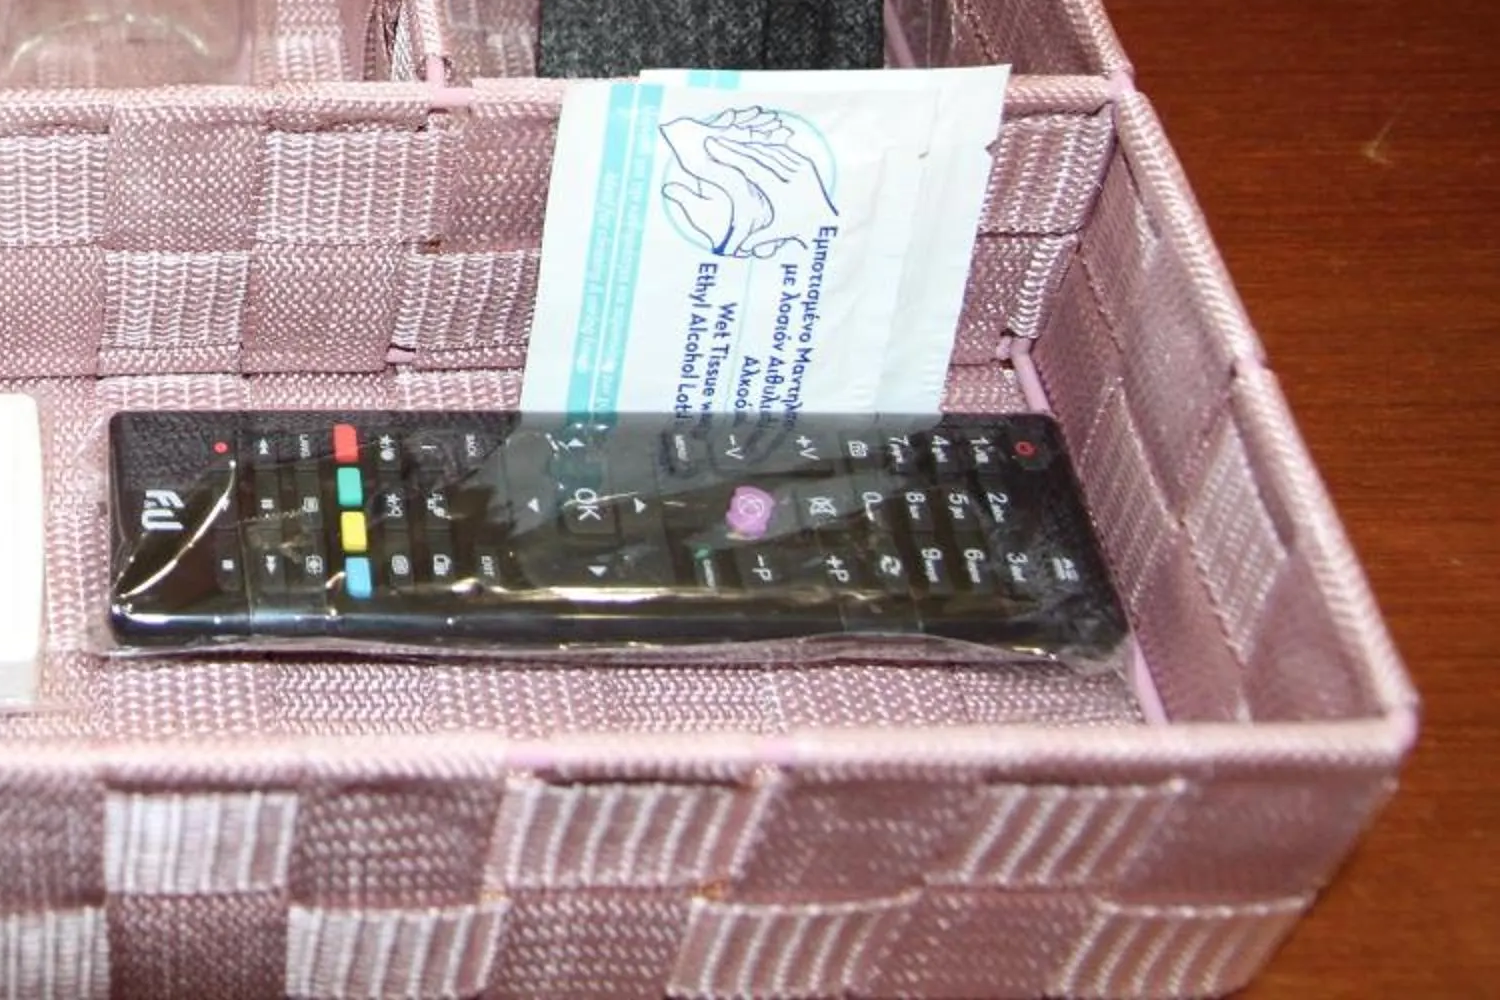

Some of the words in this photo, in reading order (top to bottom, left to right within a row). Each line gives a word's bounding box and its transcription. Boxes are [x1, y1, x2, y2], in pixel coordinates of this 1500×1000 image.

[691, 262, 718, 309] Ethyl
[779, 264, 798, 286] με
[799, 225, 838, 343] Εμποτισμένο
[680, 313, 706, 379] Alcohol
[713, 302, 738, 339] Wet
[773, 291, 801, 351] λοσιόν
[703, 344, 729, 397] Tissue
[734, 355, 759, 409] Αλκοό
[759, 355, 784, 412] Αιθυλι
[781, 347, 812, 413] Μαντηλ
[675, 384, 696, 415] Lot
[574, 487, 601, 521] OK
